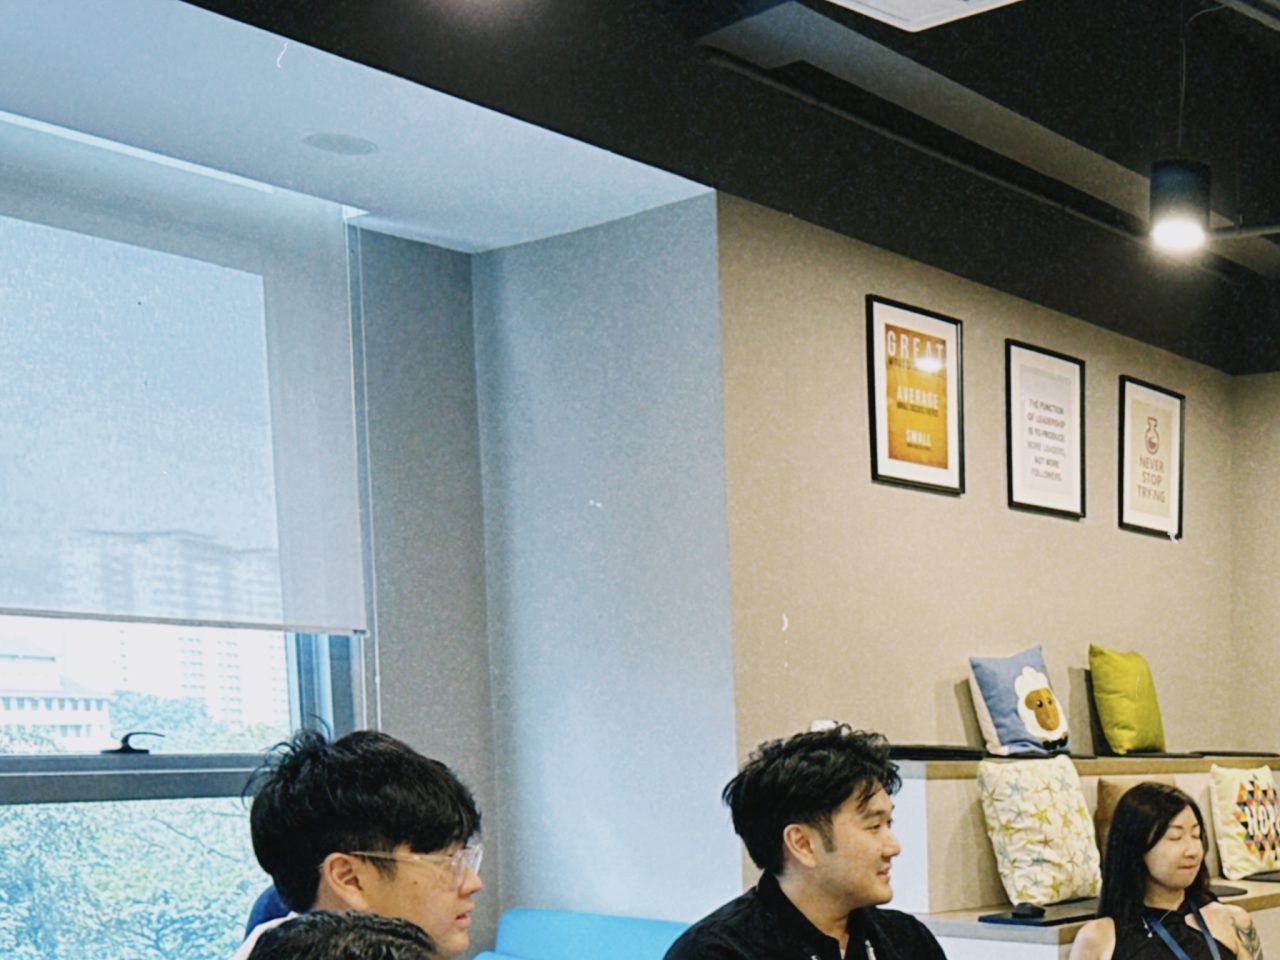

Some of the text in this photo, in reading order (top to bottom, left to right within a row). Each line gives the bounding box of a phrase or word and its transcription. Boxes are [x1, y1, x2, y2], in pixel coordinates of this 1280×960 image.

[887, 329, 945, 364] GREAT
[897, 384, 940, 410] AVERAGE
[1039, 401, 1065, 415] FUNCTION
[905, 428, 932, 448] SMALL
[1139, 456, 1165, 473] NEVER
[1141, 471, 1163, 487] STOP
[1137, 485, 1166, 503] TRYING
